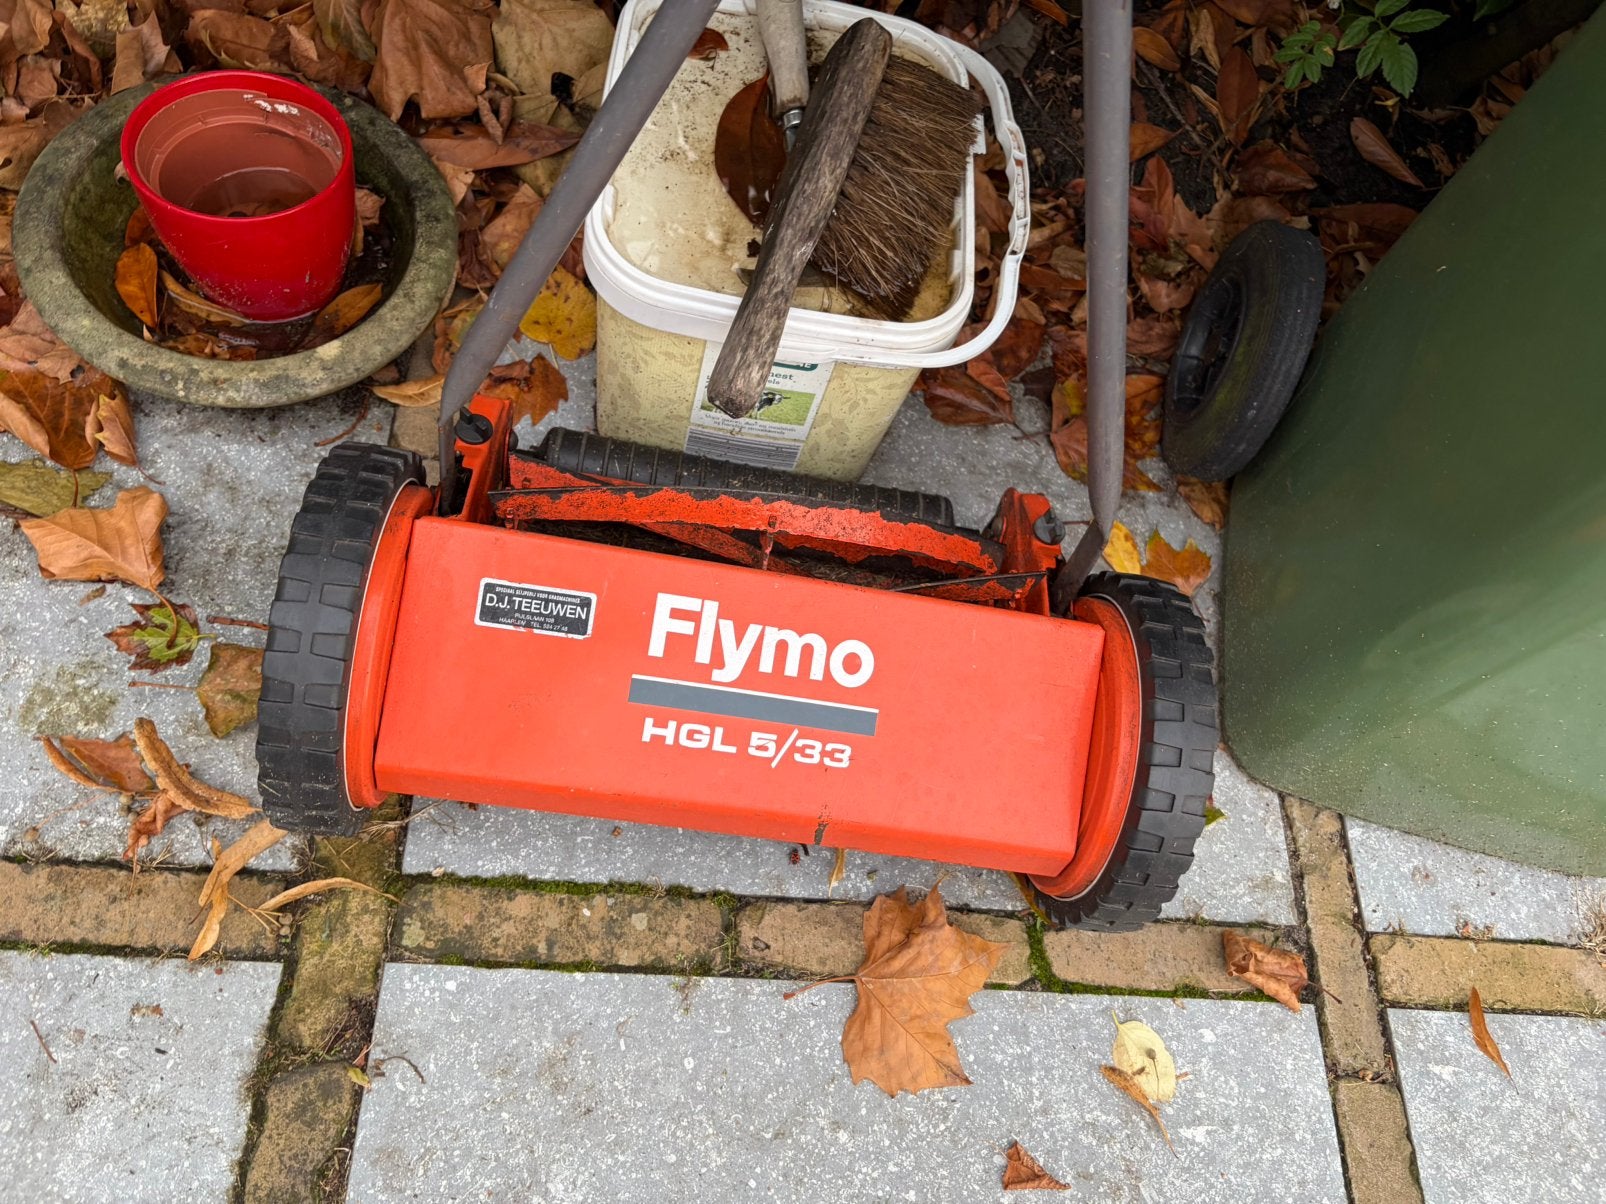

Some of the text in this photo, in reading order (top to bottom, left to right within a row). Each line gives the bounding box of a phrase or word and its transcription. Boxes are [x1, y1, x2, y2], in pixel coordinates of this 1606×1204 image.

[485, 593, 587, 620] D.J. TEEUWEN
[648, 592, 875, 688] Flymo
[641, 717, 852, 769] HGL 5/33
